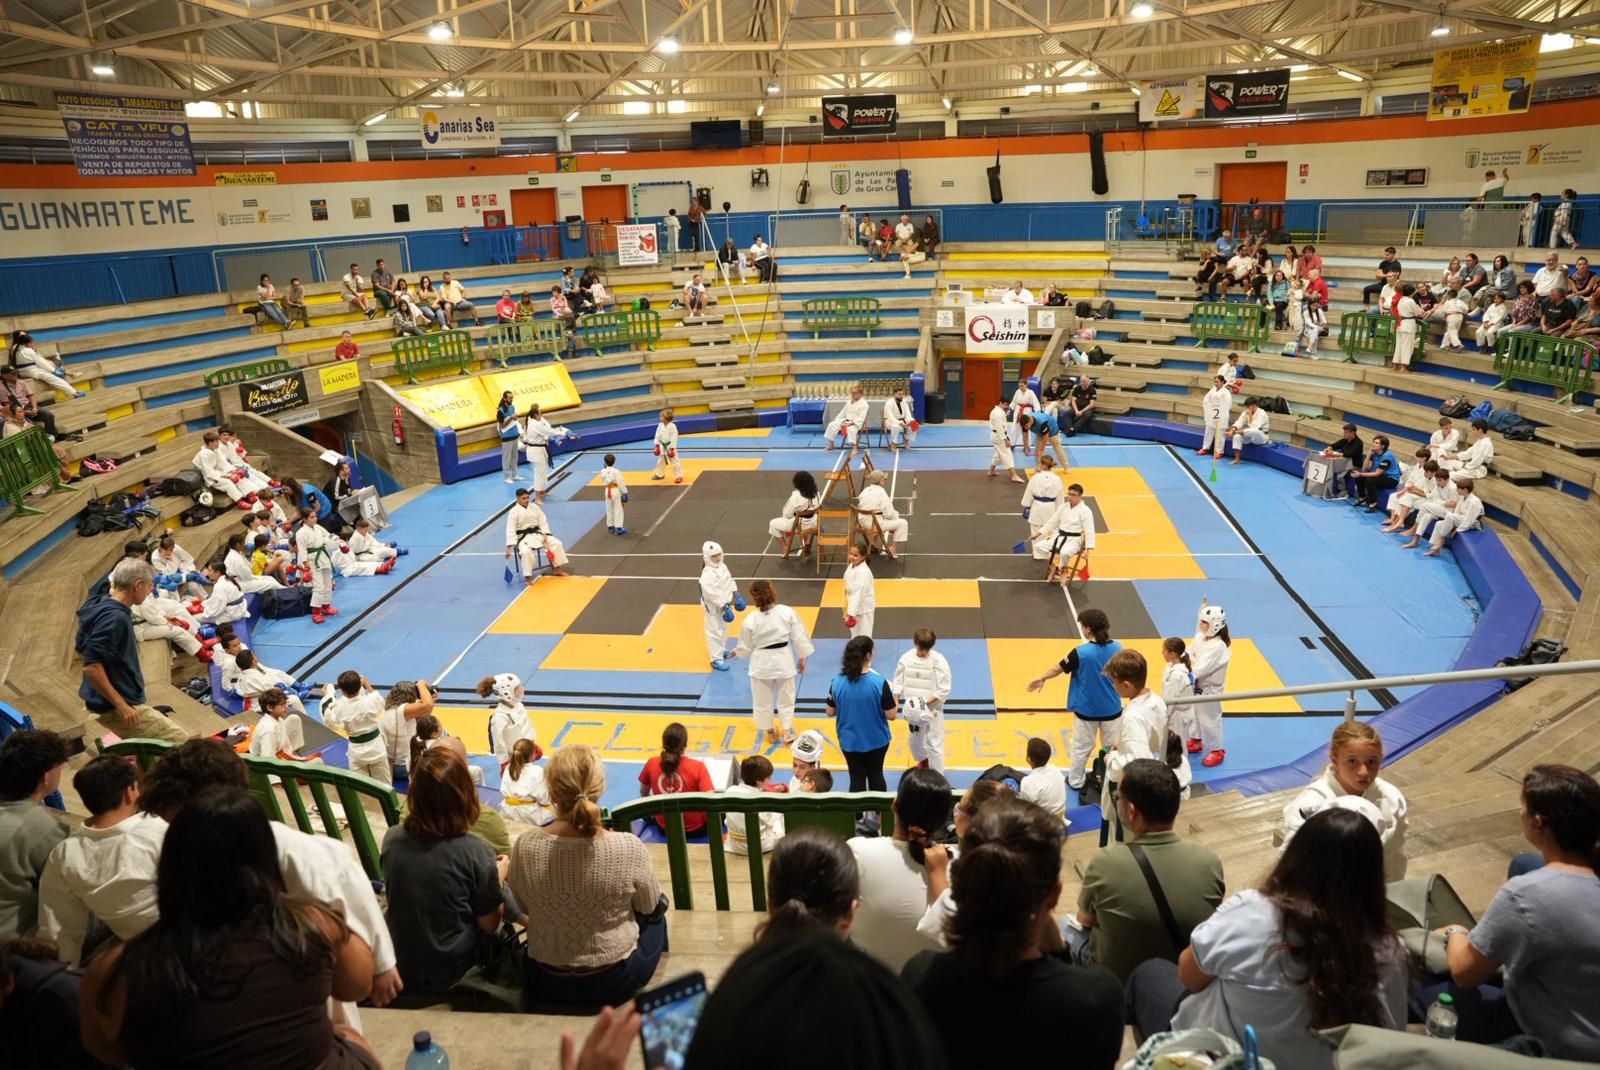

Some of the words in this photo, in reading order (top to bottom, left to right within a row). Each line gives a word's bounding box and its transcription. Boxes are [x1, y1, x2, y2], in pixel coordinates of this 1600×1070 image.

[57, 95, 79, 105] AUTO
[85, 121, 119, 131] CAT
[138, 123, 168, 132] VFU
[423, 111, 472, 144] Canarias
[475, 116, 495, 133] Sea
[71, 138, 128, 146] RECOGEMOS
[122, 146, 145, 154] PARA
[982, 330, 1026, 341] Seishin
[322, 378, 331, 386] LA
[332, 372, 357, 385] MADERA
[520, 382, 558, 396] MADERA
[437, 399, 474, 414] MADERA
[1212, 408, 1220, 420] 2
[1313, 467, 1321, 481] 2
